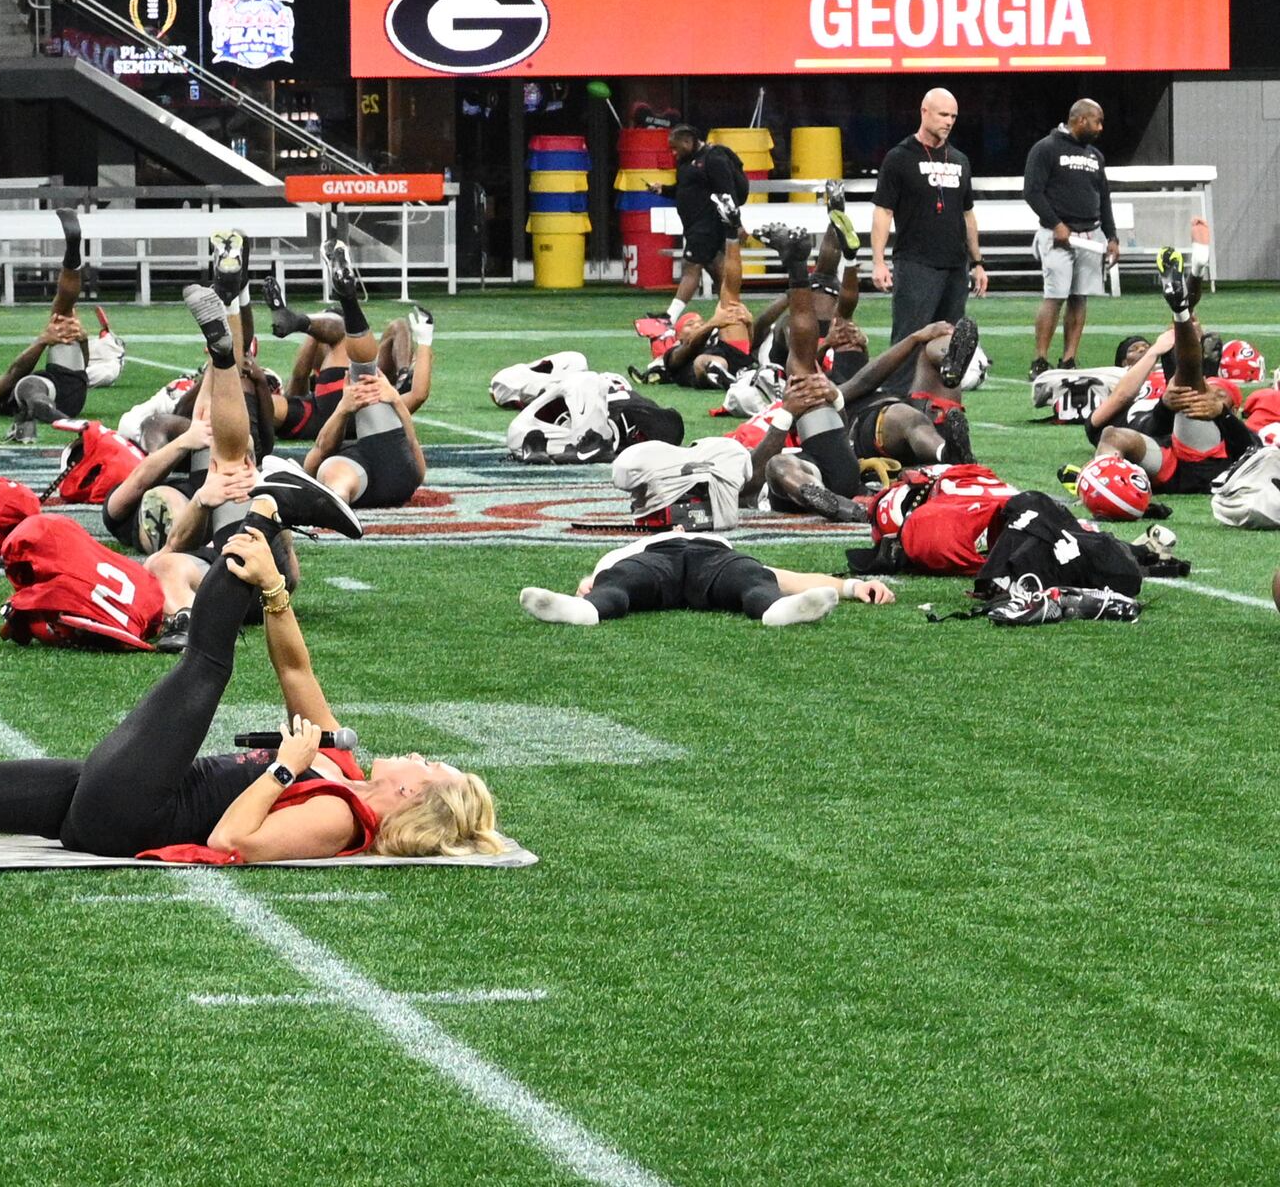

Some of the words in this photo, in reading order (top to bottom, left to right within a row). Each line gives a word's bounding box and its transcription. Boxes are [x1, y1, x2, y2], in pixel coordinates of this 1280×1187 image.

[919, 161, 962, 177] NOBODY
[321, 180, 409, 195] GATORADE
[90, 562, 136, 628] 2
